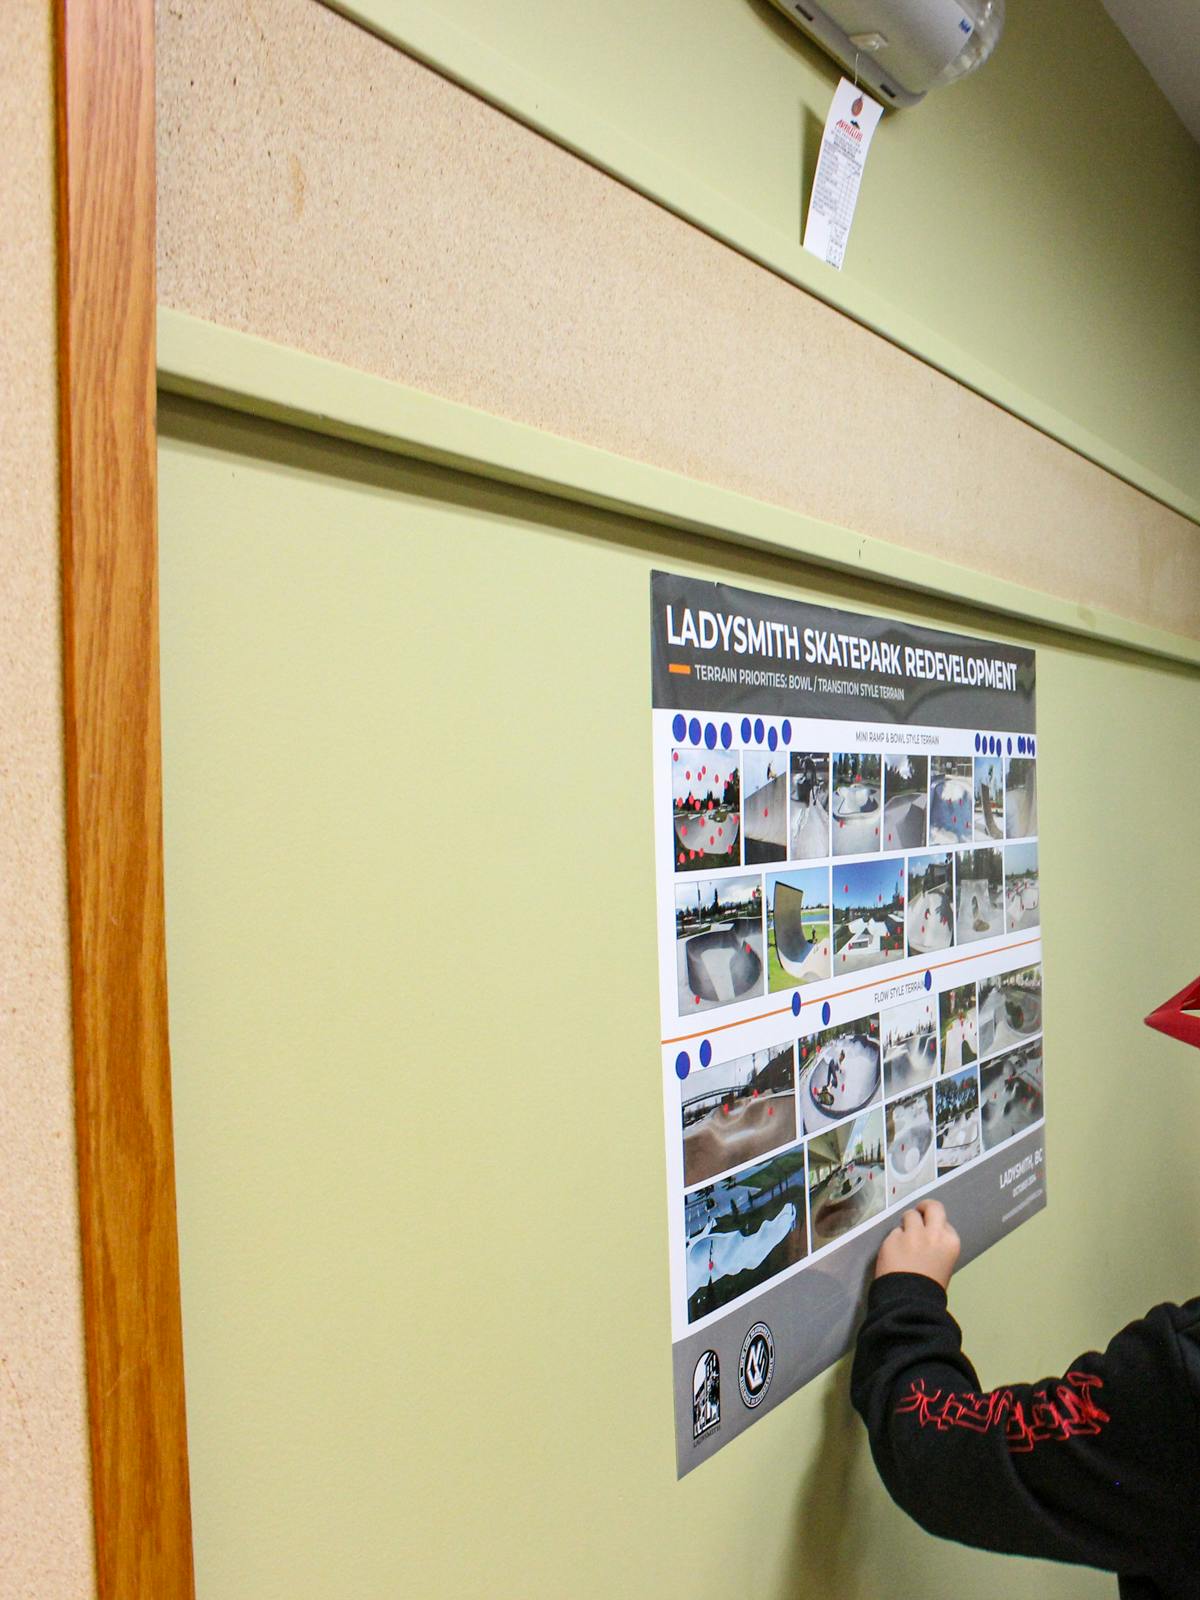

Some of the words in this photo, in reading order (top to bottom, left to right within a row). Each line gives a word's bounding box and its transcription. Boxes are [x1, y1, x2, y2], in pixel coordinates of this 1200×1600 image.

[665, 604, 800, 661] LADYSMITH
[803, 628, 902, 677] SKATEPARK
[904, 646, 1017, 691] REDEVELOPMENT
[694, 663, 738, 684] TERRAIN
[739, 668, 788, 689] PRIORITIES:
[789, 674, 812, 693] BOWL
[818, 678, 860, 696] TRANSITION
[860, 682, 879, 698] STYLE
[879, 685, 905, 701] TERRAIN
[855, 731, 869, 742] MINI
[869, 731, 885, 743] RAMP
[890, 732, 906, 744] BOWL
[906, 733, 920, 745] STYLE
[920, 734, 939, 745] TERRAIN
[874, 990, 889, 1004] FLOW
[889, 985, 904, 999] STYLE
[1034, 1148, 1043, 1165] BC
